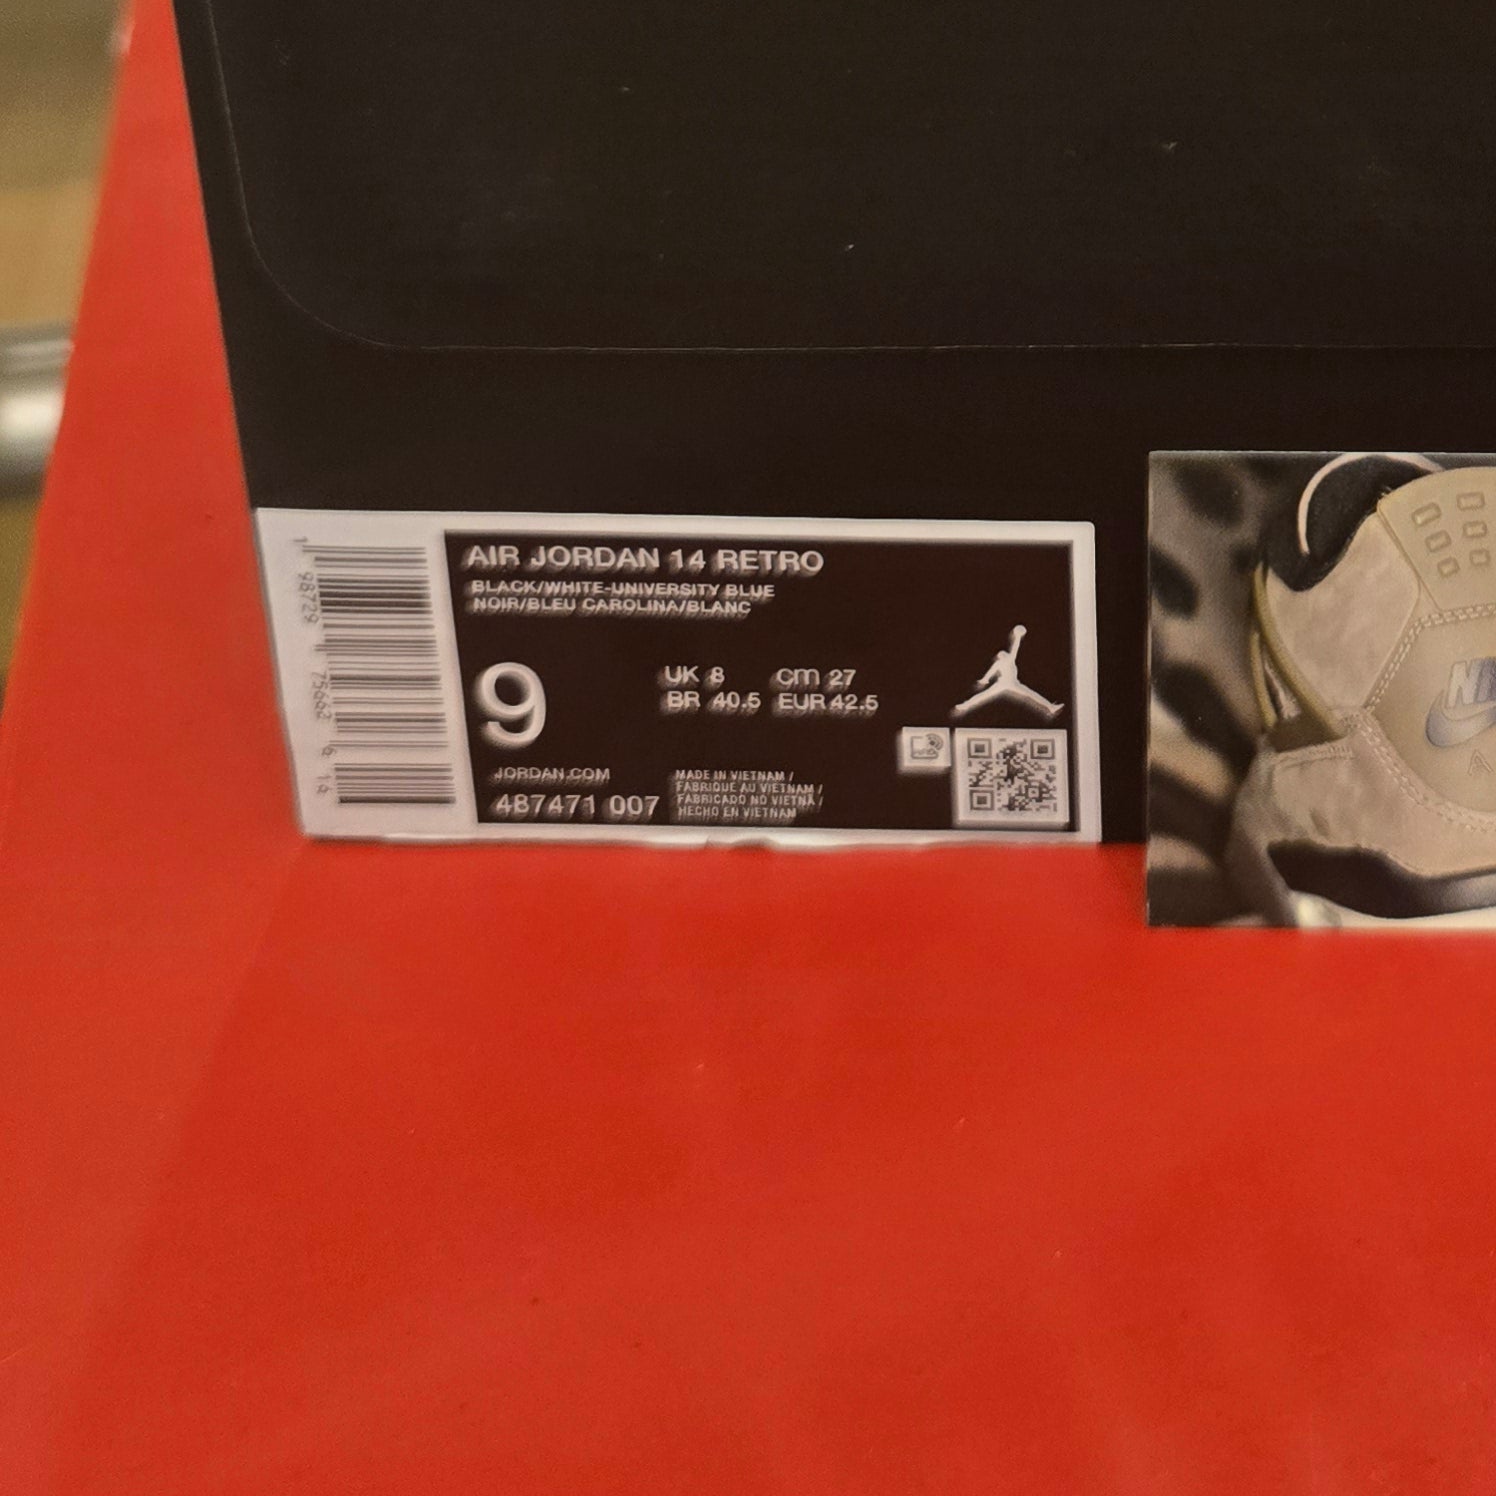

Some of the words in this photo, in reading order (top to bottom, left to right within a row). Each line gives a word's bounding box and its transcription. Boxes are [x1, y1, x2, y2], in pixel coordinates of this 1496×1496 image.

[467, 545, 520, 567] AIR
[530, 546, 660, 569] JORDAN
[669, 549, 706, 570] 14
[717, 549, 824, 572] RETRO
[298, 571, 320, 625] 98729
[471, 580, 720, 597] BLACK/WHITE-UNIVERSITY
[727, 584, 775, 599] BLUE
[473, 597, 577, 612] NOIR/BLEU
[584, 598, 752, 615] CAROLINA/BLANC
[664, 665, 700, 684] UK
[710, 667, 725, 684] 8
[829, 669, 857, 687] 27
[479, 661, 547, 747] 9
[666, 691, 701, 708] BR
[713, 692, 761, 710] 40.5
[777, 694, 825, 711] EUR
[831, 694, 879, 712] 42.5
[494, 766, 611, 781] JORDAN.COM
[675, 769, 710, 780] MADE
[713, 770, 727, 780] IN
[730, 770, 785, 781] VIETNAM
[675, 781, 737, 793] FABRIQUE
[740, 782, 756, 793] AU
[759, 783, 814, 794] VIETNAM
[495, 794, 597, 815] 487471
[609, 795, 661, 816] 007
[676, 794, 746, 805] FABRICADO
[749, 794, 768, 805] NO
[678, 806, 719, 817] HECHO
[723, 807, 739, 817] EN
[743, 807, 797, 818] VIETNAM
